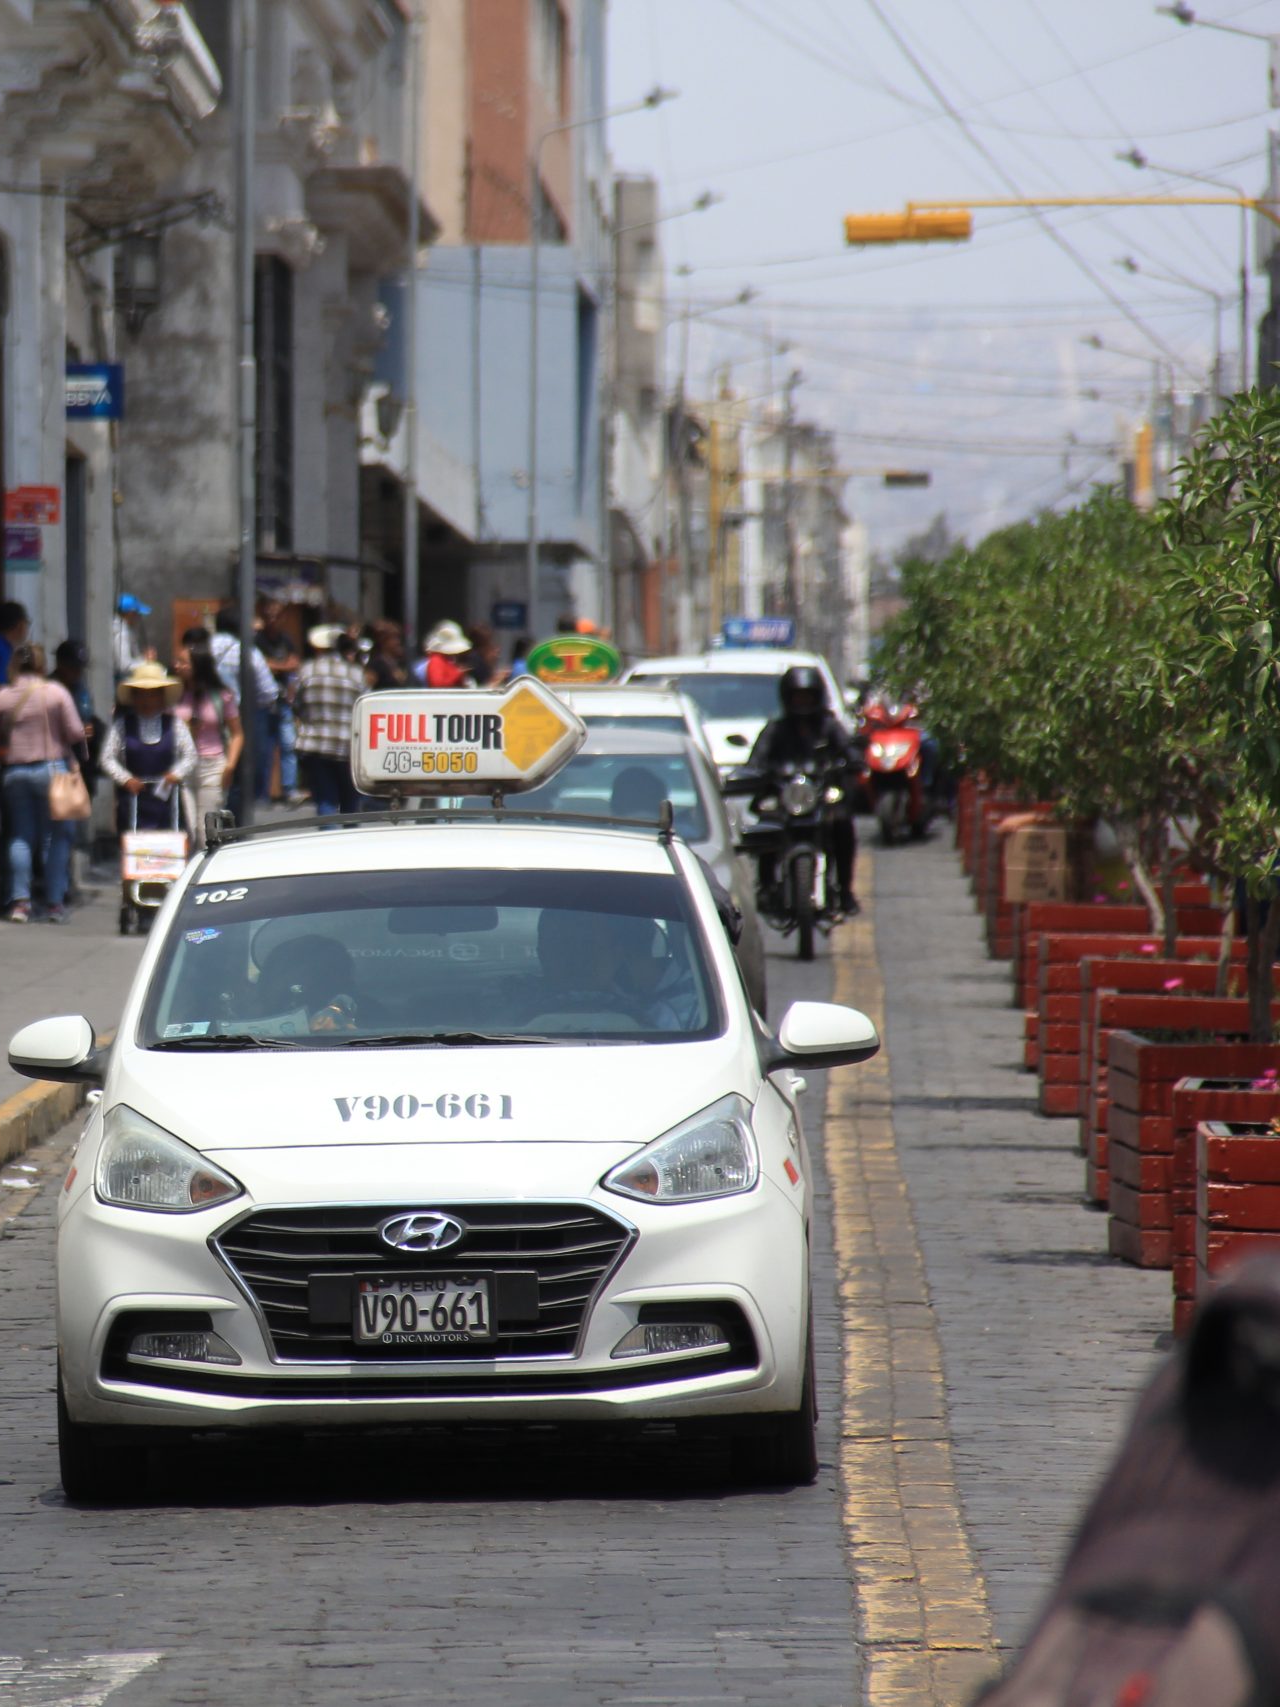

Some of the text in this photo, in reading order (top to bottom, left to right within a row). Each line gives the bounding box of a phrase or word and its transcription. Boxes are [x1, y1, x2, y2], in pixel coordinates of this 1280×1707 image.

[65, 389, 113, 406] BBVA
[383, 751, 479, 774] 46-5050
[195, 887, 249, 905] 102
[333, 1093, 514, 1123] V90-661
[361, 1292, 487, 1334] V90-661
